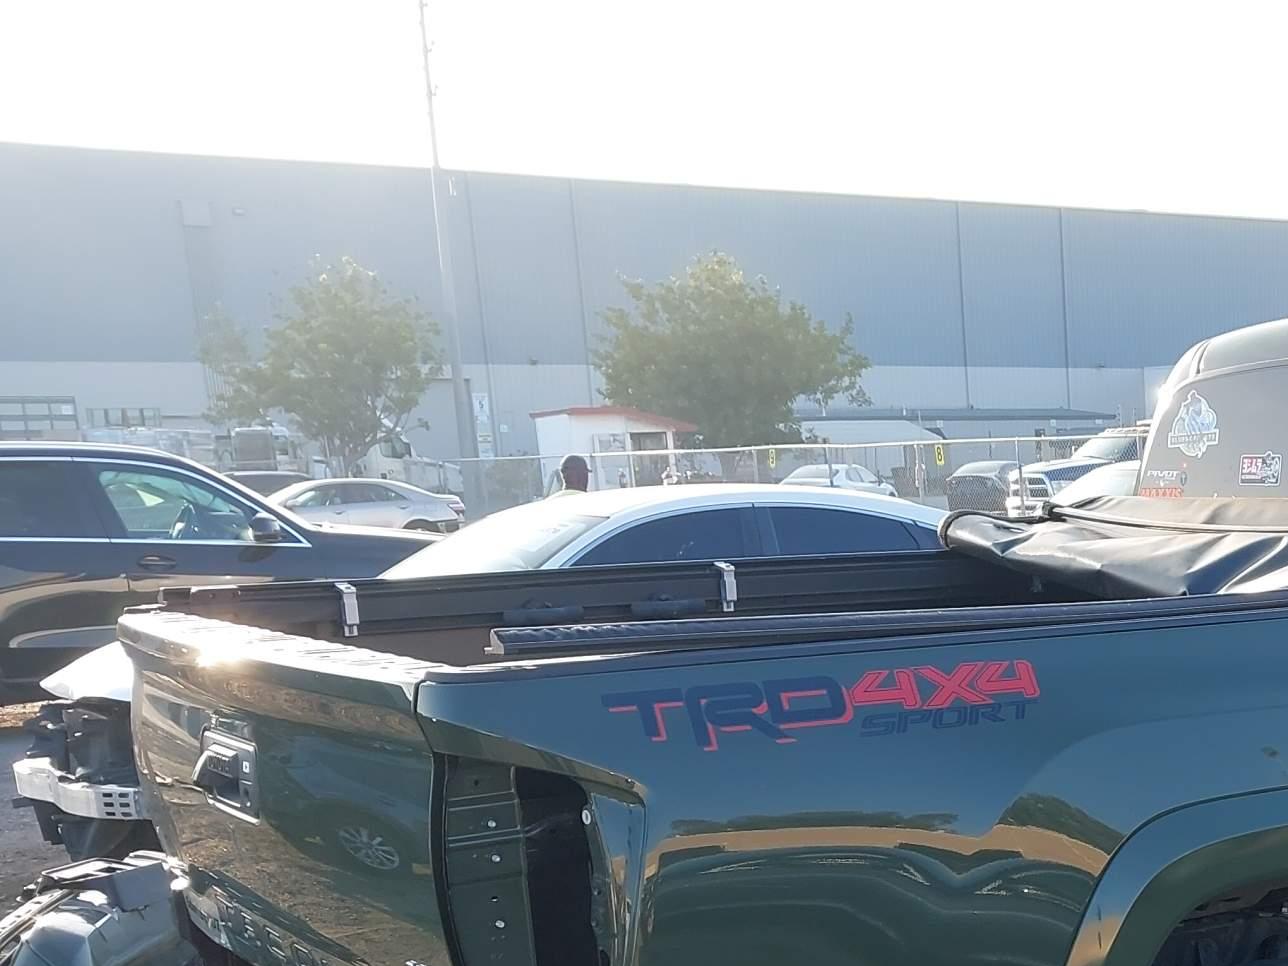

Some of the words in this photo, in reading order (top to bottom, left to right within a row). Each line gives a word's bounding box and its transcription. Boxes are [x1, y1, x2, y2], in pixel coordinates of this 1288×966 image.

[935, 446, 943, 462] 8
[1147, 470, 1180, 480] PIVOT
[601, 675, 855, 751] TRD
[859, 698, 1041, 738] SPORT
